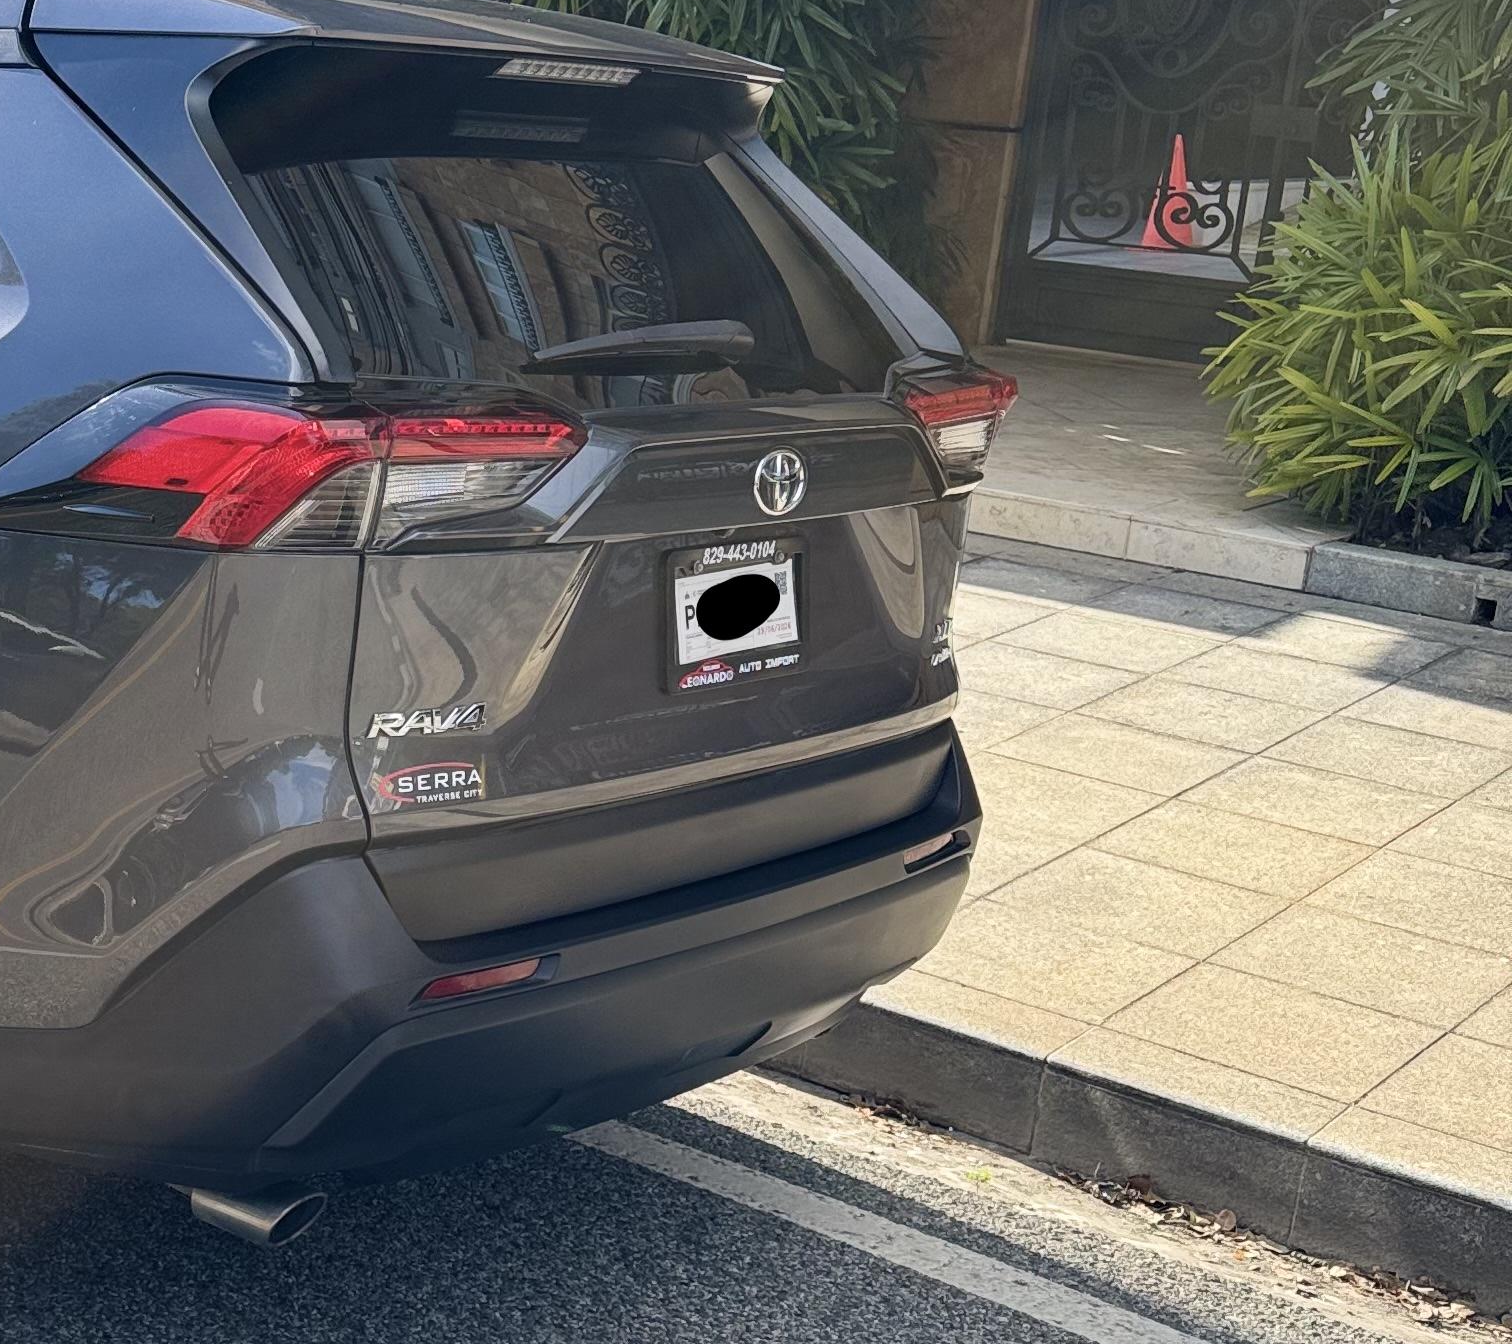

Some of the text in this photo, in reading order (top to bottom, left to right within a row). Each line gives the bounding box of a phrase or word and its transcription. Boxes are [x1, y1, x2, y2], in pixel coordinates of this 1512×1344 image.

[702, 540, 777, 565] 829-443-0104
[738, 660, 762, 673] AUTO
[765, 654, 800, 669] IMPORT
[367, 702, 487, 738] RAV4
[398, 768, 482, 793] SERRA
[416, 788, 482, 803] TRAVERSE CITY
